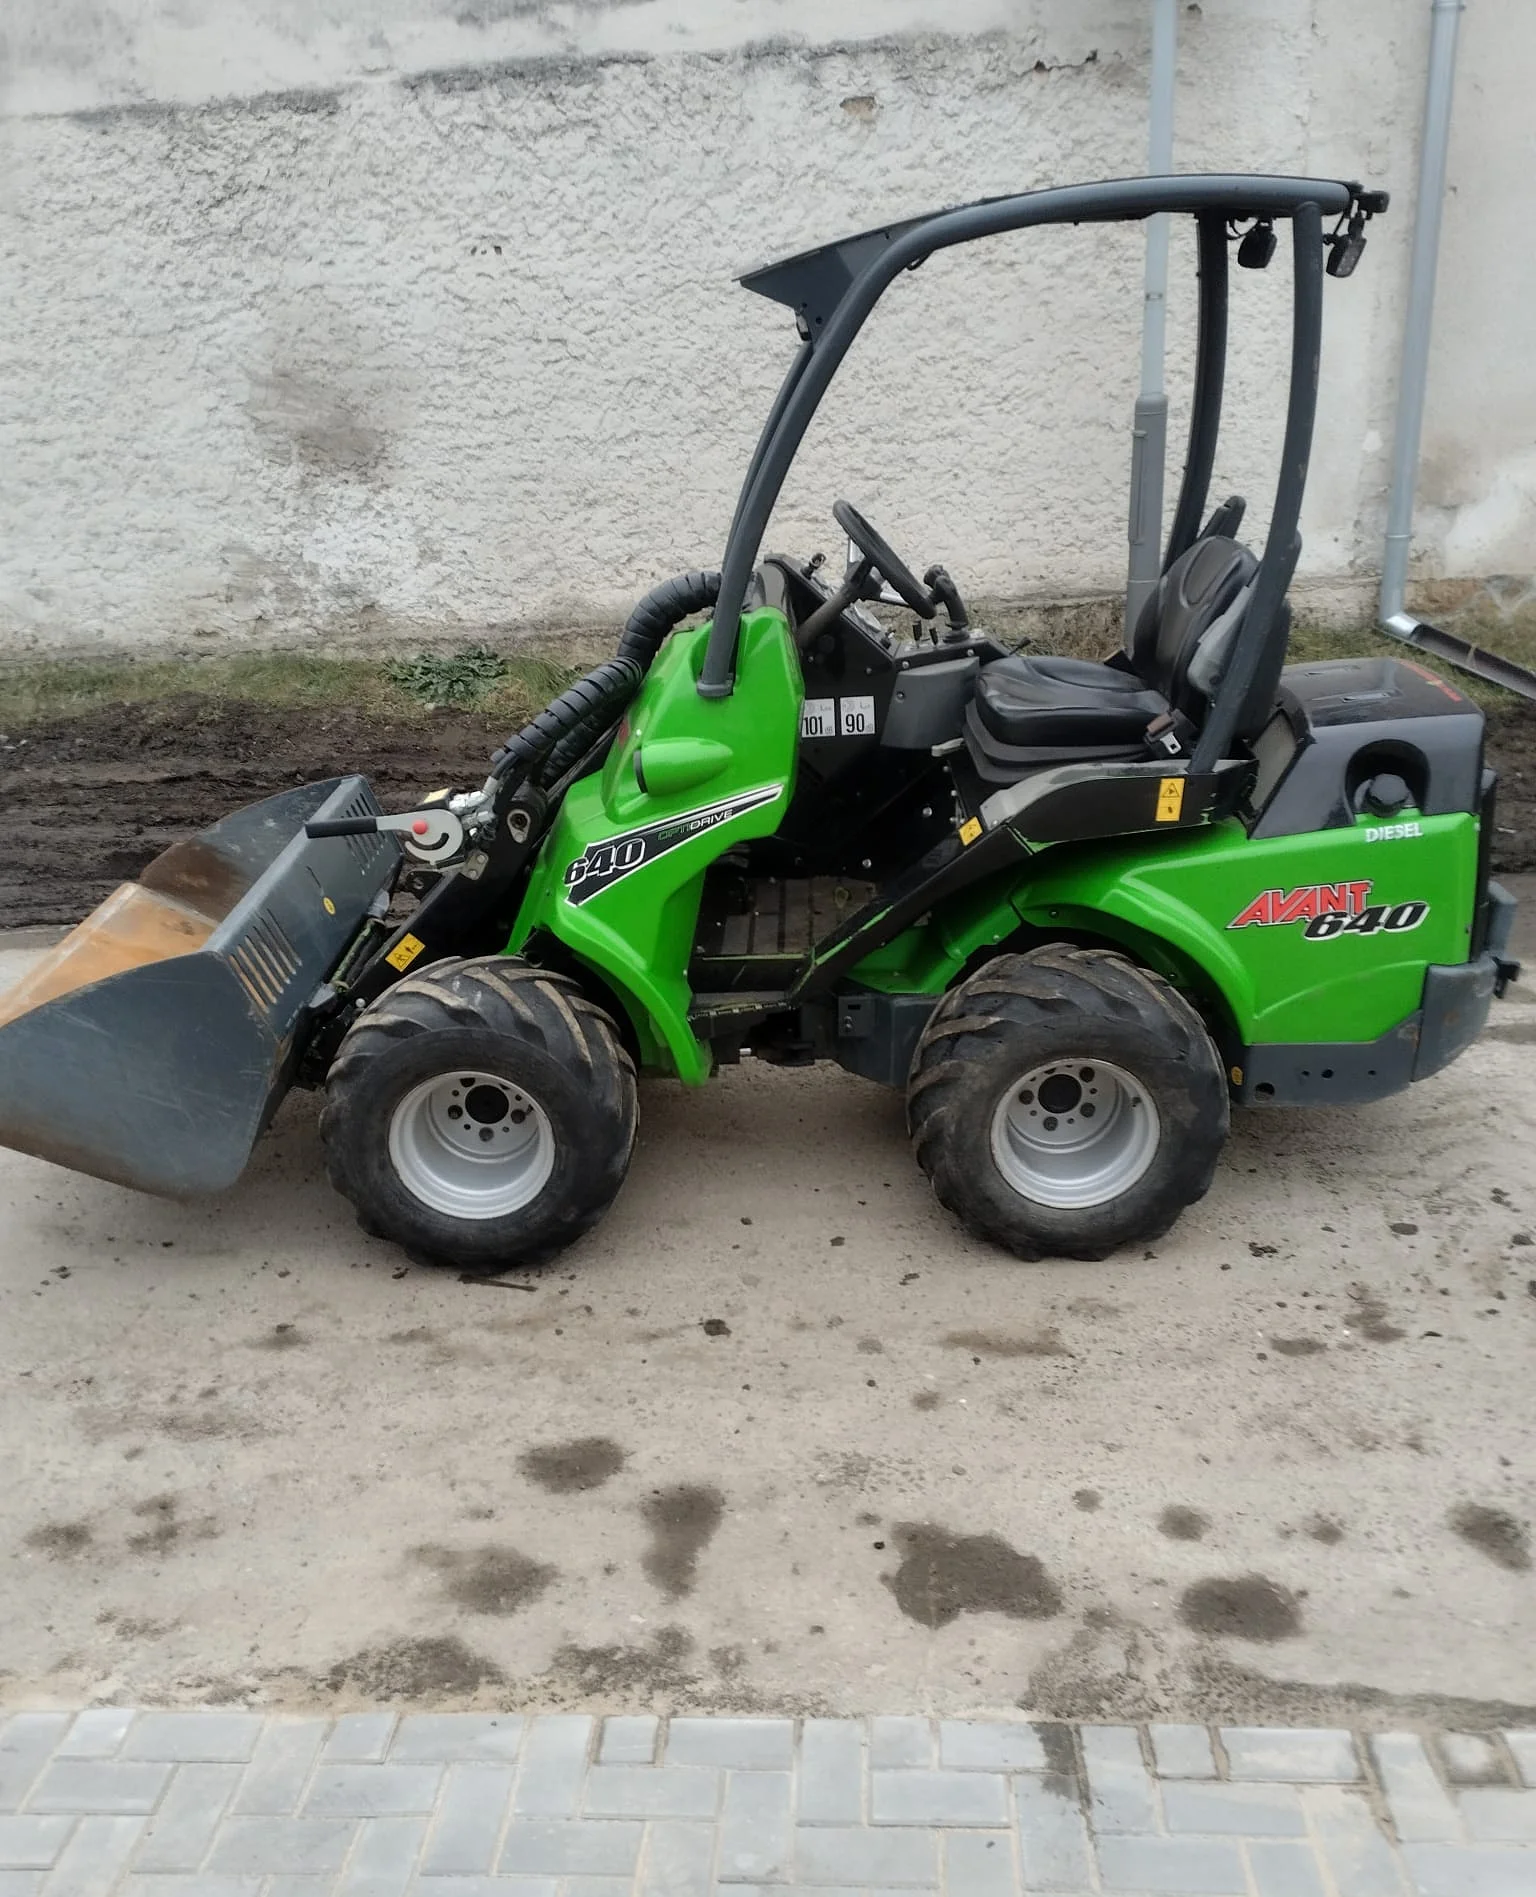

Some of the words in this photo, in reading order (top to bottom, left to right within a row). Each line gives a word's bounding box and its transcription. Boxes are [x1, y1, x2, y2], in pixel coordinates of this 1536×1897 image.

[803, 716, 823, 735] 101
[845, 713, 865, 733] 90
[1366, 822, 1423, 842] DIESEL
[563, 837, 646, 887] 640
[1225, 878, 1374, 930] AVANT
[1303, 900, 1430, 941] 640
